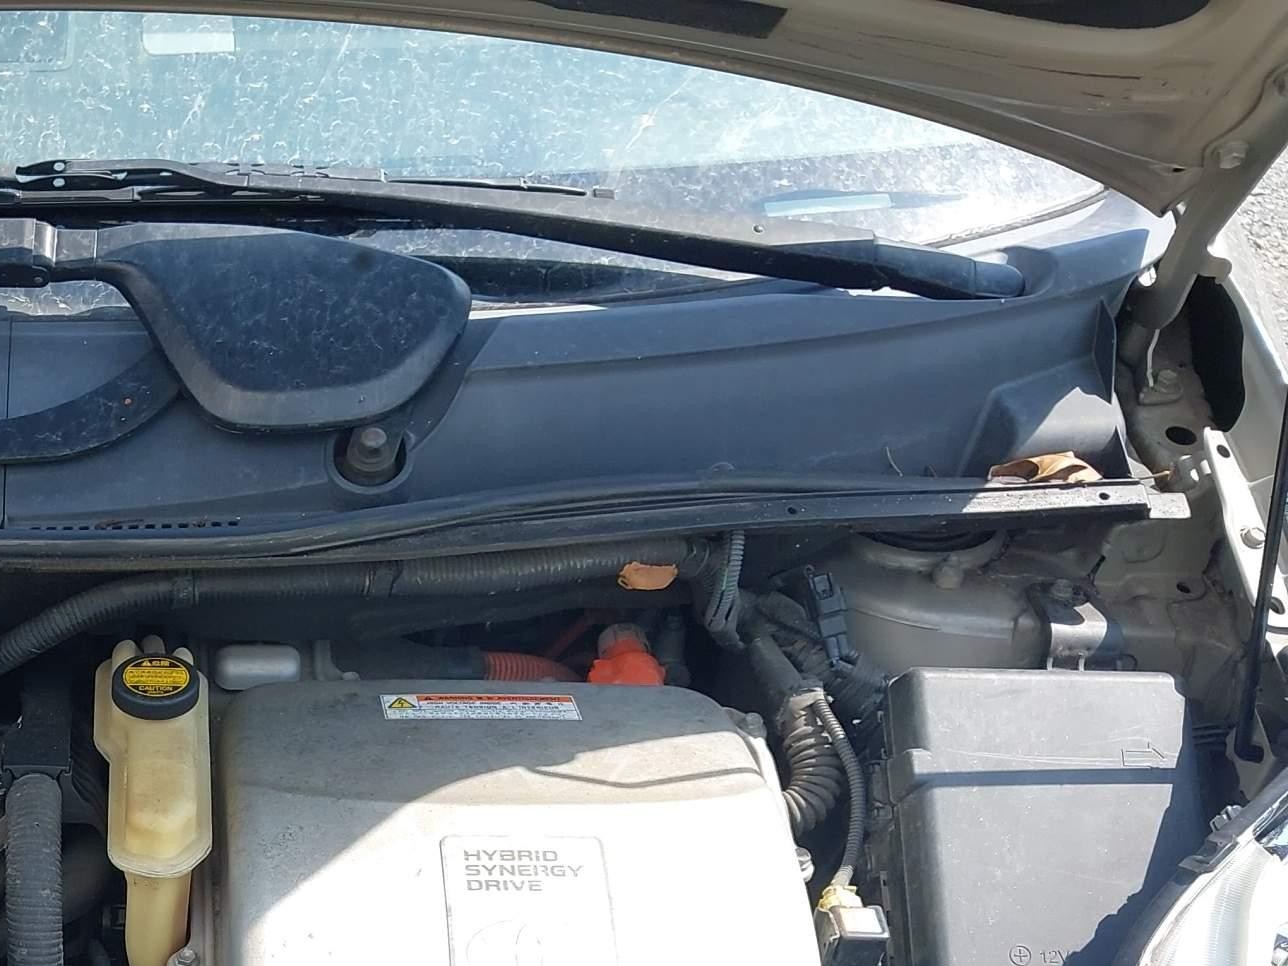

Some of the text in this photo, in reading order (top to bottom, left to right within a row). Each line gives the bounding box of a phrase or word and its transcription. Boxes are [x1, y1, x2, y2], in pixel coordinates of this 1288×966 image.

[463, 849, 559, 861] HYBRID
[464, 864, 583, 877] SYNERGY
[466, 879, 544, 892] DRIVE
